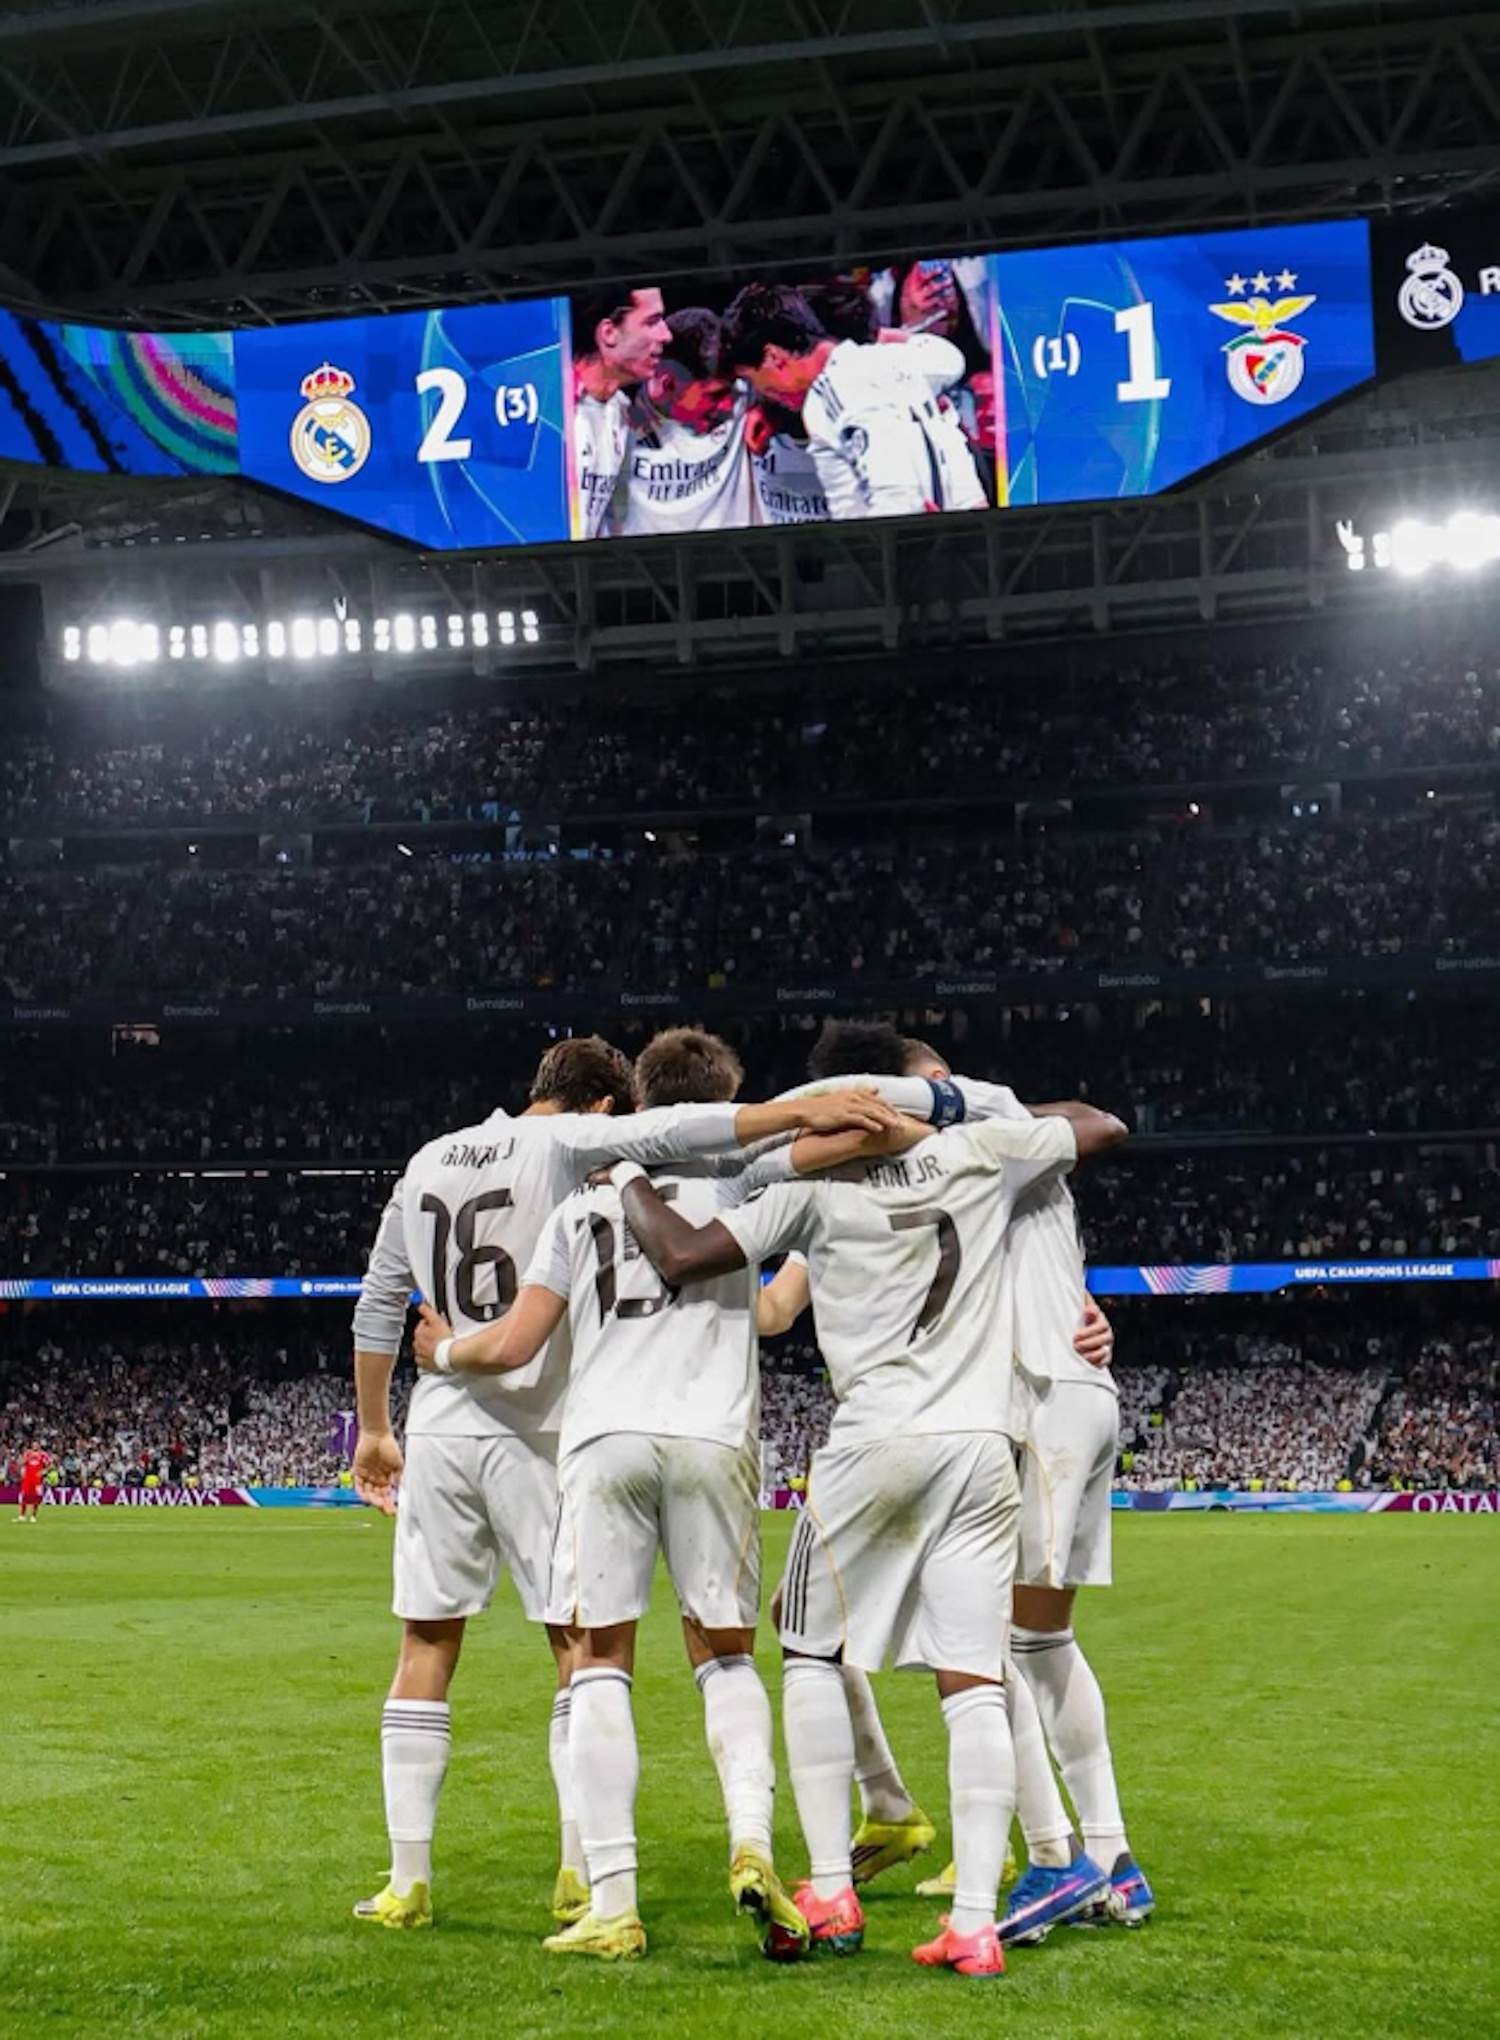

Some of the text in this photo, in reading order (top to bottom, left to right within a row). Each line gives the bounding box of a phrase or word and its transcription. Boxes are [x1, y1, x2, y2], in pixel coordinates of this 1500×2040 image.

[1033, 302, 1172, 402] (1) 1
[416, 367, 538, 463] 2 (3)
[634, 456, 719, 482] Emirat
[760, 482, 829, 515] Emirate
[916, 1154, 950, 1184] JR.
[420, 1187, 519, 1327] 16
[1295, 1264, 1454, 1278] UEFA CHAMPIONS LEAGUE
[52, 1283, 190, 1294] UEFA CHAMPIONS LEAGUE
[314, 1282, 361, 1293] crypto.co
[888, 1208, 962, 1346] 7
[42, 1487, 221, 1505] ATAR AIRWAYS
[1412, 1492, 1500, 1513] QATA
